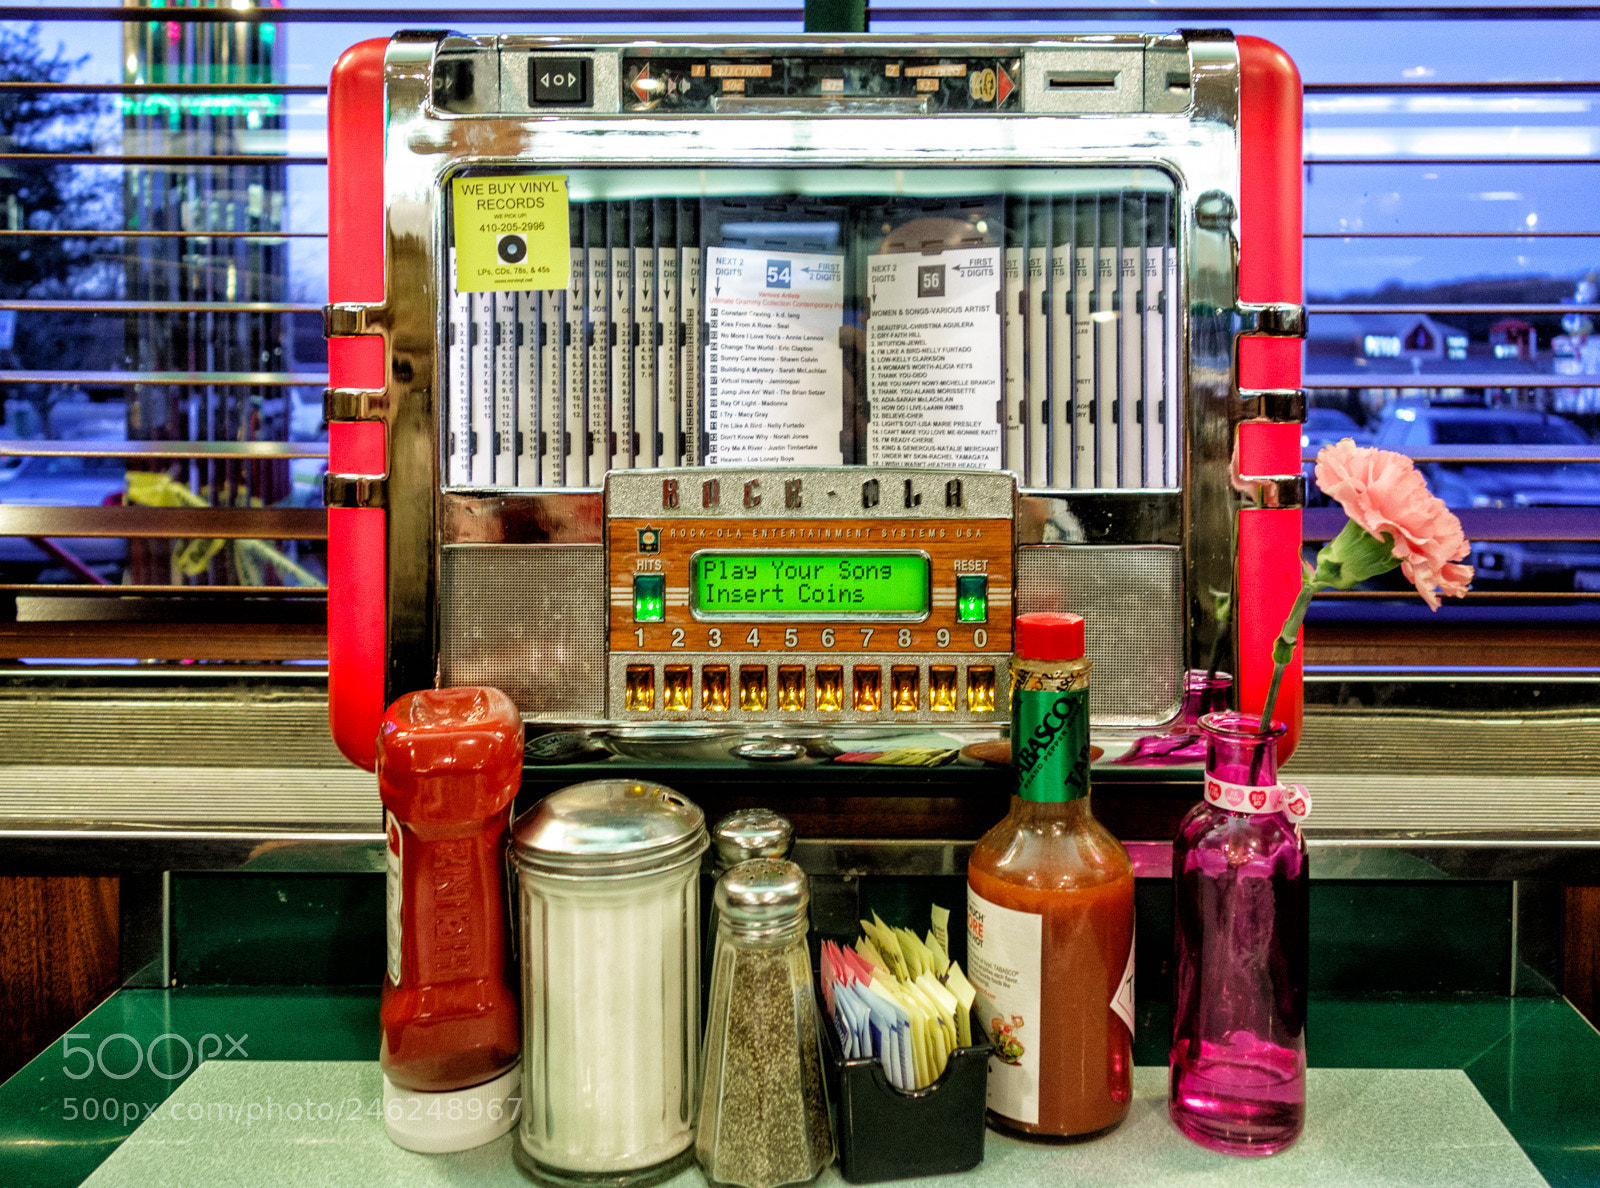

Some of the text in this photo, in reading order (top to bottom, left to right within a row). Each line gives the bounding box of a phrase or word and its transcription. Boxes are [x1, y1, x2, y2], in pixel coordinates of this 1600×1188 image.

[713, 65, 762, 76] SELECTION
[462, 181, 559, 195] WE BUY VINYL
[478, 197, 544, 210] RECORDS
[480, 222, 545, 232] 410-205-2996
[514, 267, 528, 275] 78s,
[767, 267, 790, 283] 54
[816, 273, 841, 281] DIGITS
[967, 269, 993, 277] DIGITS
[924, 273, 939, 288] 56
[736, 298, 761, 306] Grammy
[965, 305, 990, 313] ARTIST
[671, 528, 982, 538] ROCK-OLA ENTERTAINMENT SYSTEMS USA
[637, 559, 662, 571] HITS
[704, 560, 892, 580] Play Your Song
[953, 559, 989, 571] RESET
[706, 583, 865, 603] Insert Coins
[634, 629, 987, 647] 1 2 3 4 5 6 7 8 9 0
[1044, 731, 1067, 761] PEPPER
[968, 914, 983, 938] ORE
